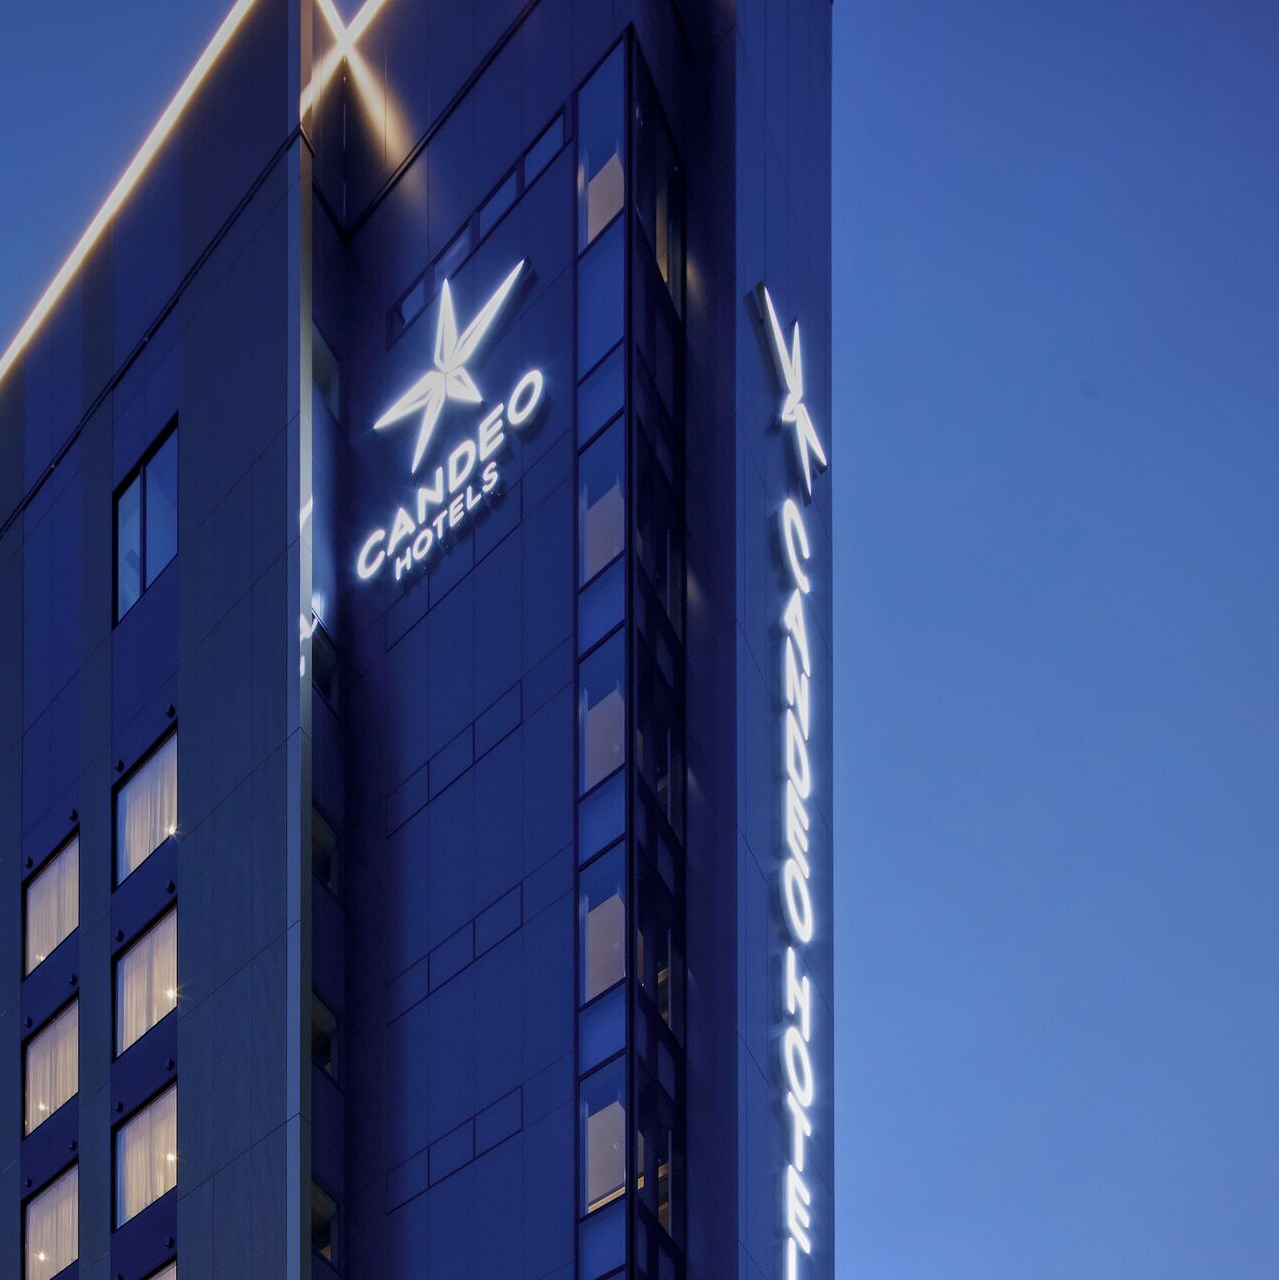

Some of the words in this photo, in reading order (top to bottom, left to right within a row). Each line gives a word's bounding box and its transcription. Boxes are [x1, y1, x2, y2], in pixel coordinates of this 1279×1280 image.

[357, 370, 544, 580] CANDEO
[394, 461, 500, 582] HOTELS
[782, 499, 813, 943] CANDEO
